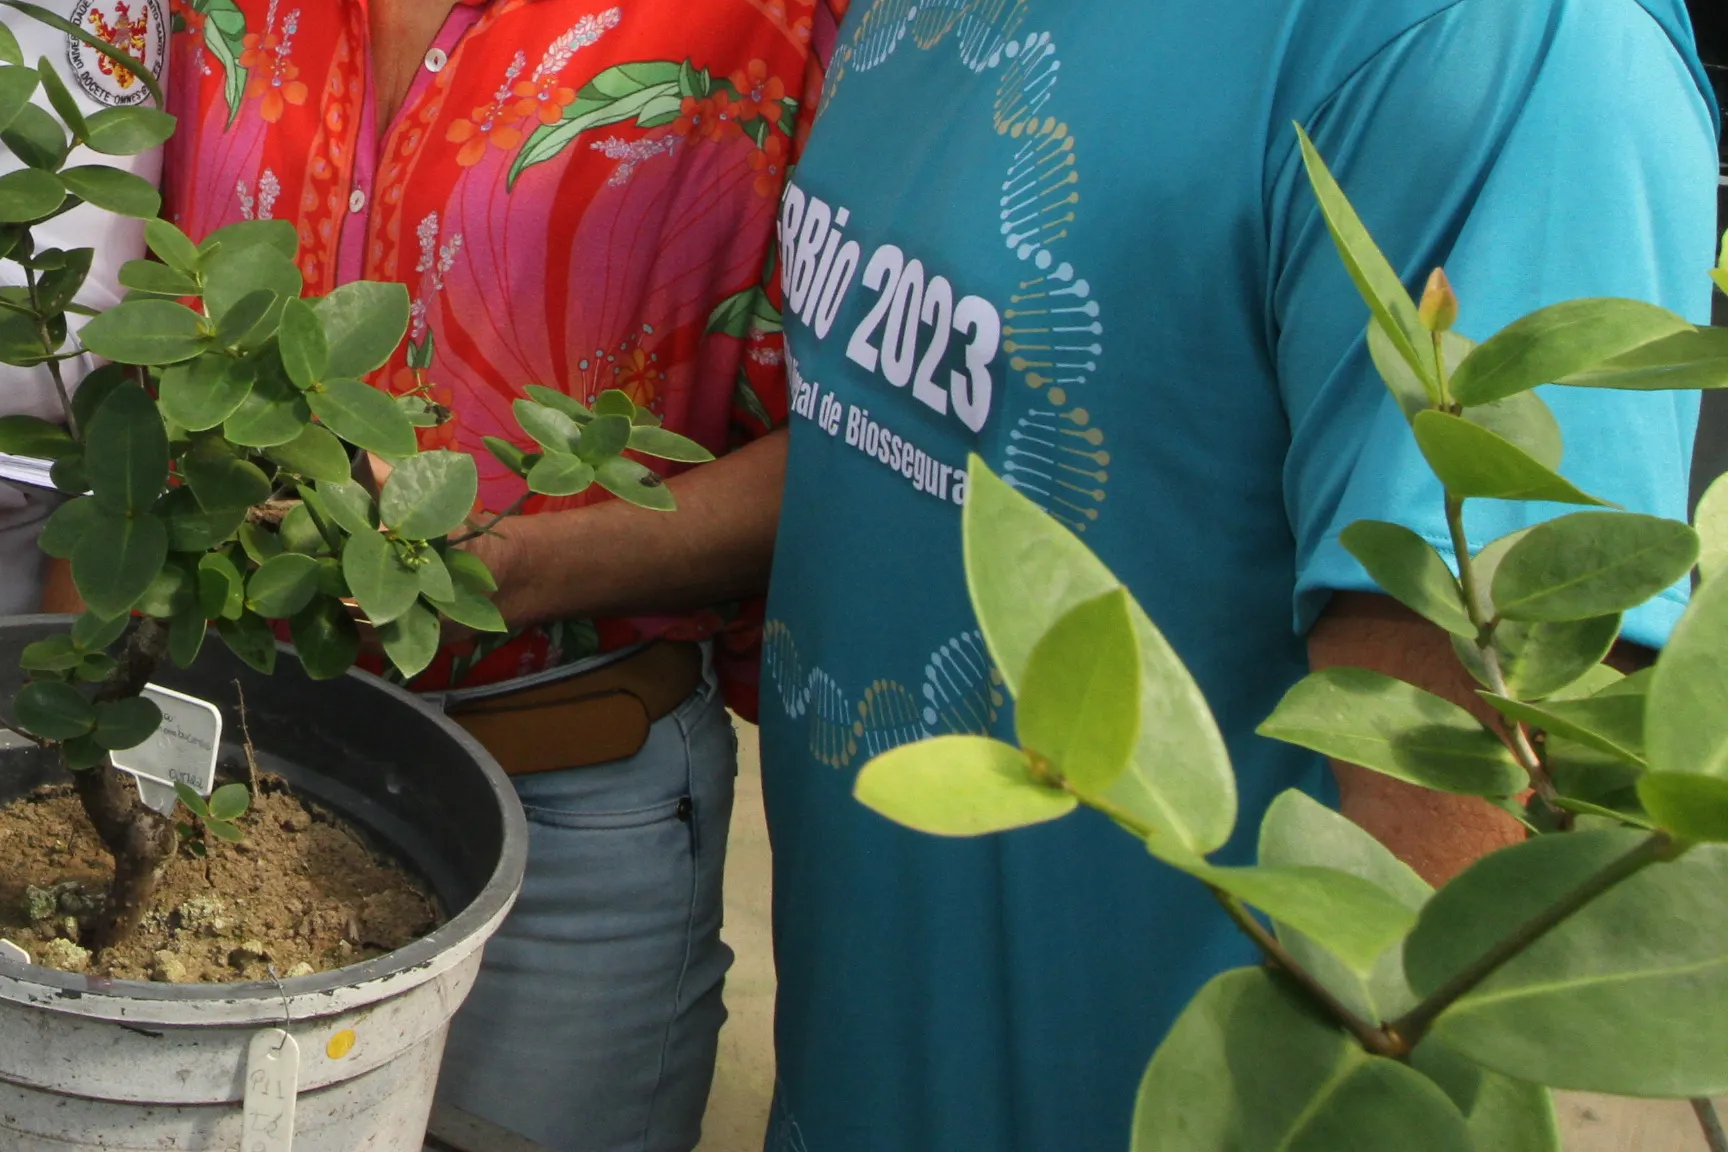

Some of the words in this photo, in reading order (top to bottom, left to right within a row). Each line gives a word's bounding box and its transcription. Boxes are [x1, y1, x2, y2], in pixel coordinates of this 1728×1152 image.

[80, 70, 111, 102] DOCETE
[777, 181, 861, 340] BBio
[845, 243, 1001, 434] 2023
[818, 391, 843, 437] de
[844, 404, 970, 506] Biossegura
